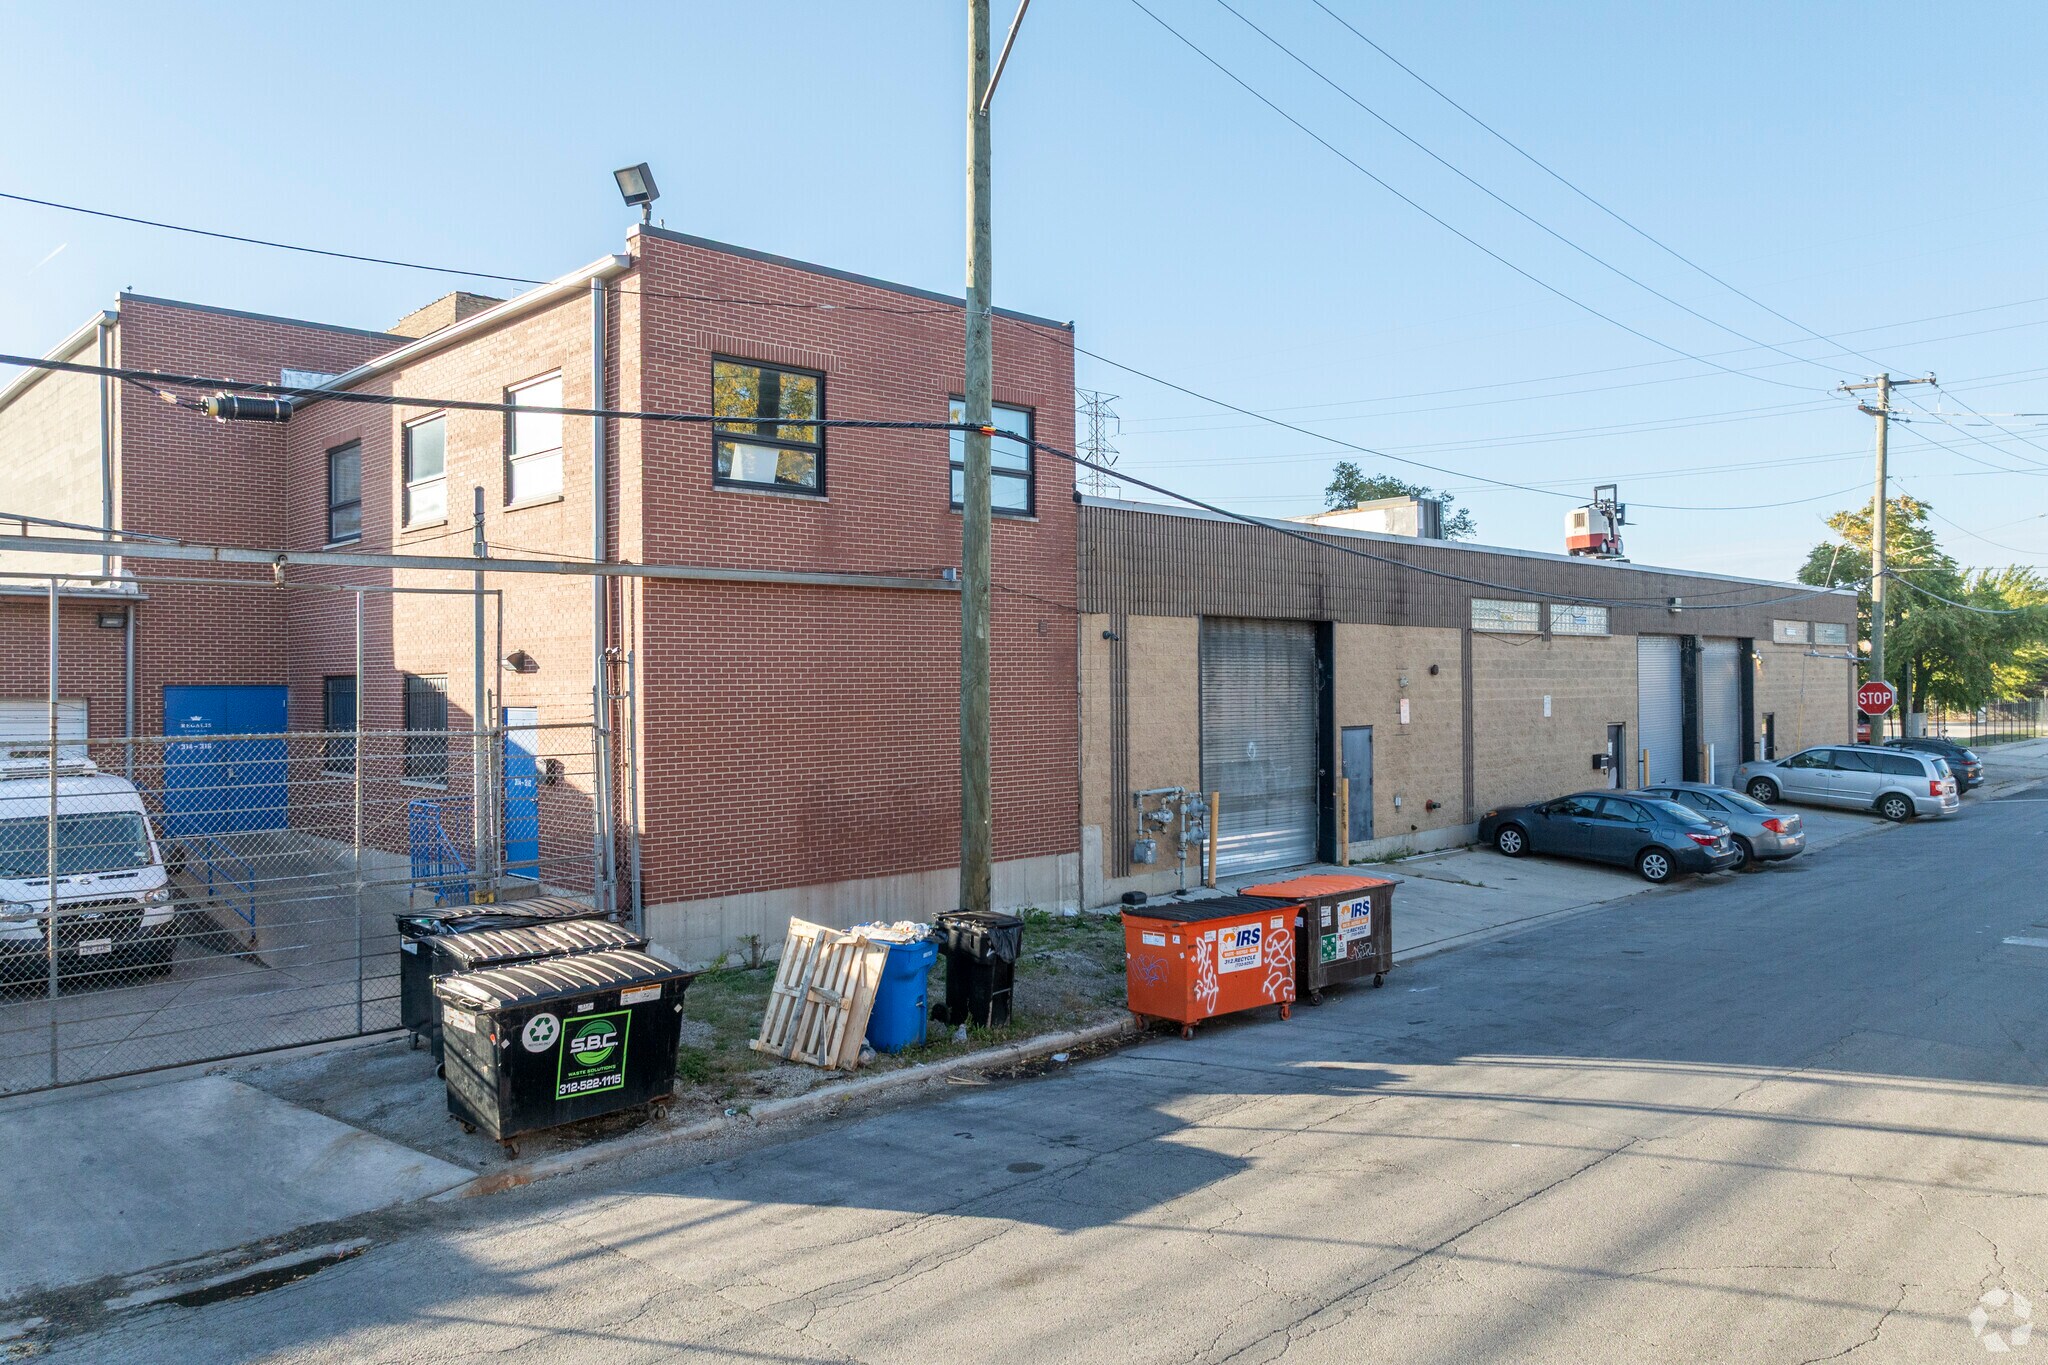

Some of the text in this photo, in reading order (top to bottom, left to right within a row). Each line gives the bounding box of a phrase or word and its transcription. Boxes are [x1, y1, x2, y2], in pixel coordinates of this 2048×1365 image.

[1859, 692, 1891, 705] STOP
[1350, 900, 1370, 918] IRS
[1236, 928, 1261, 947] IRS
[569, 1031, 619, 1054] S.B.C.
[568, 1064, 617, 1077] WASTE SOLUTIONS
